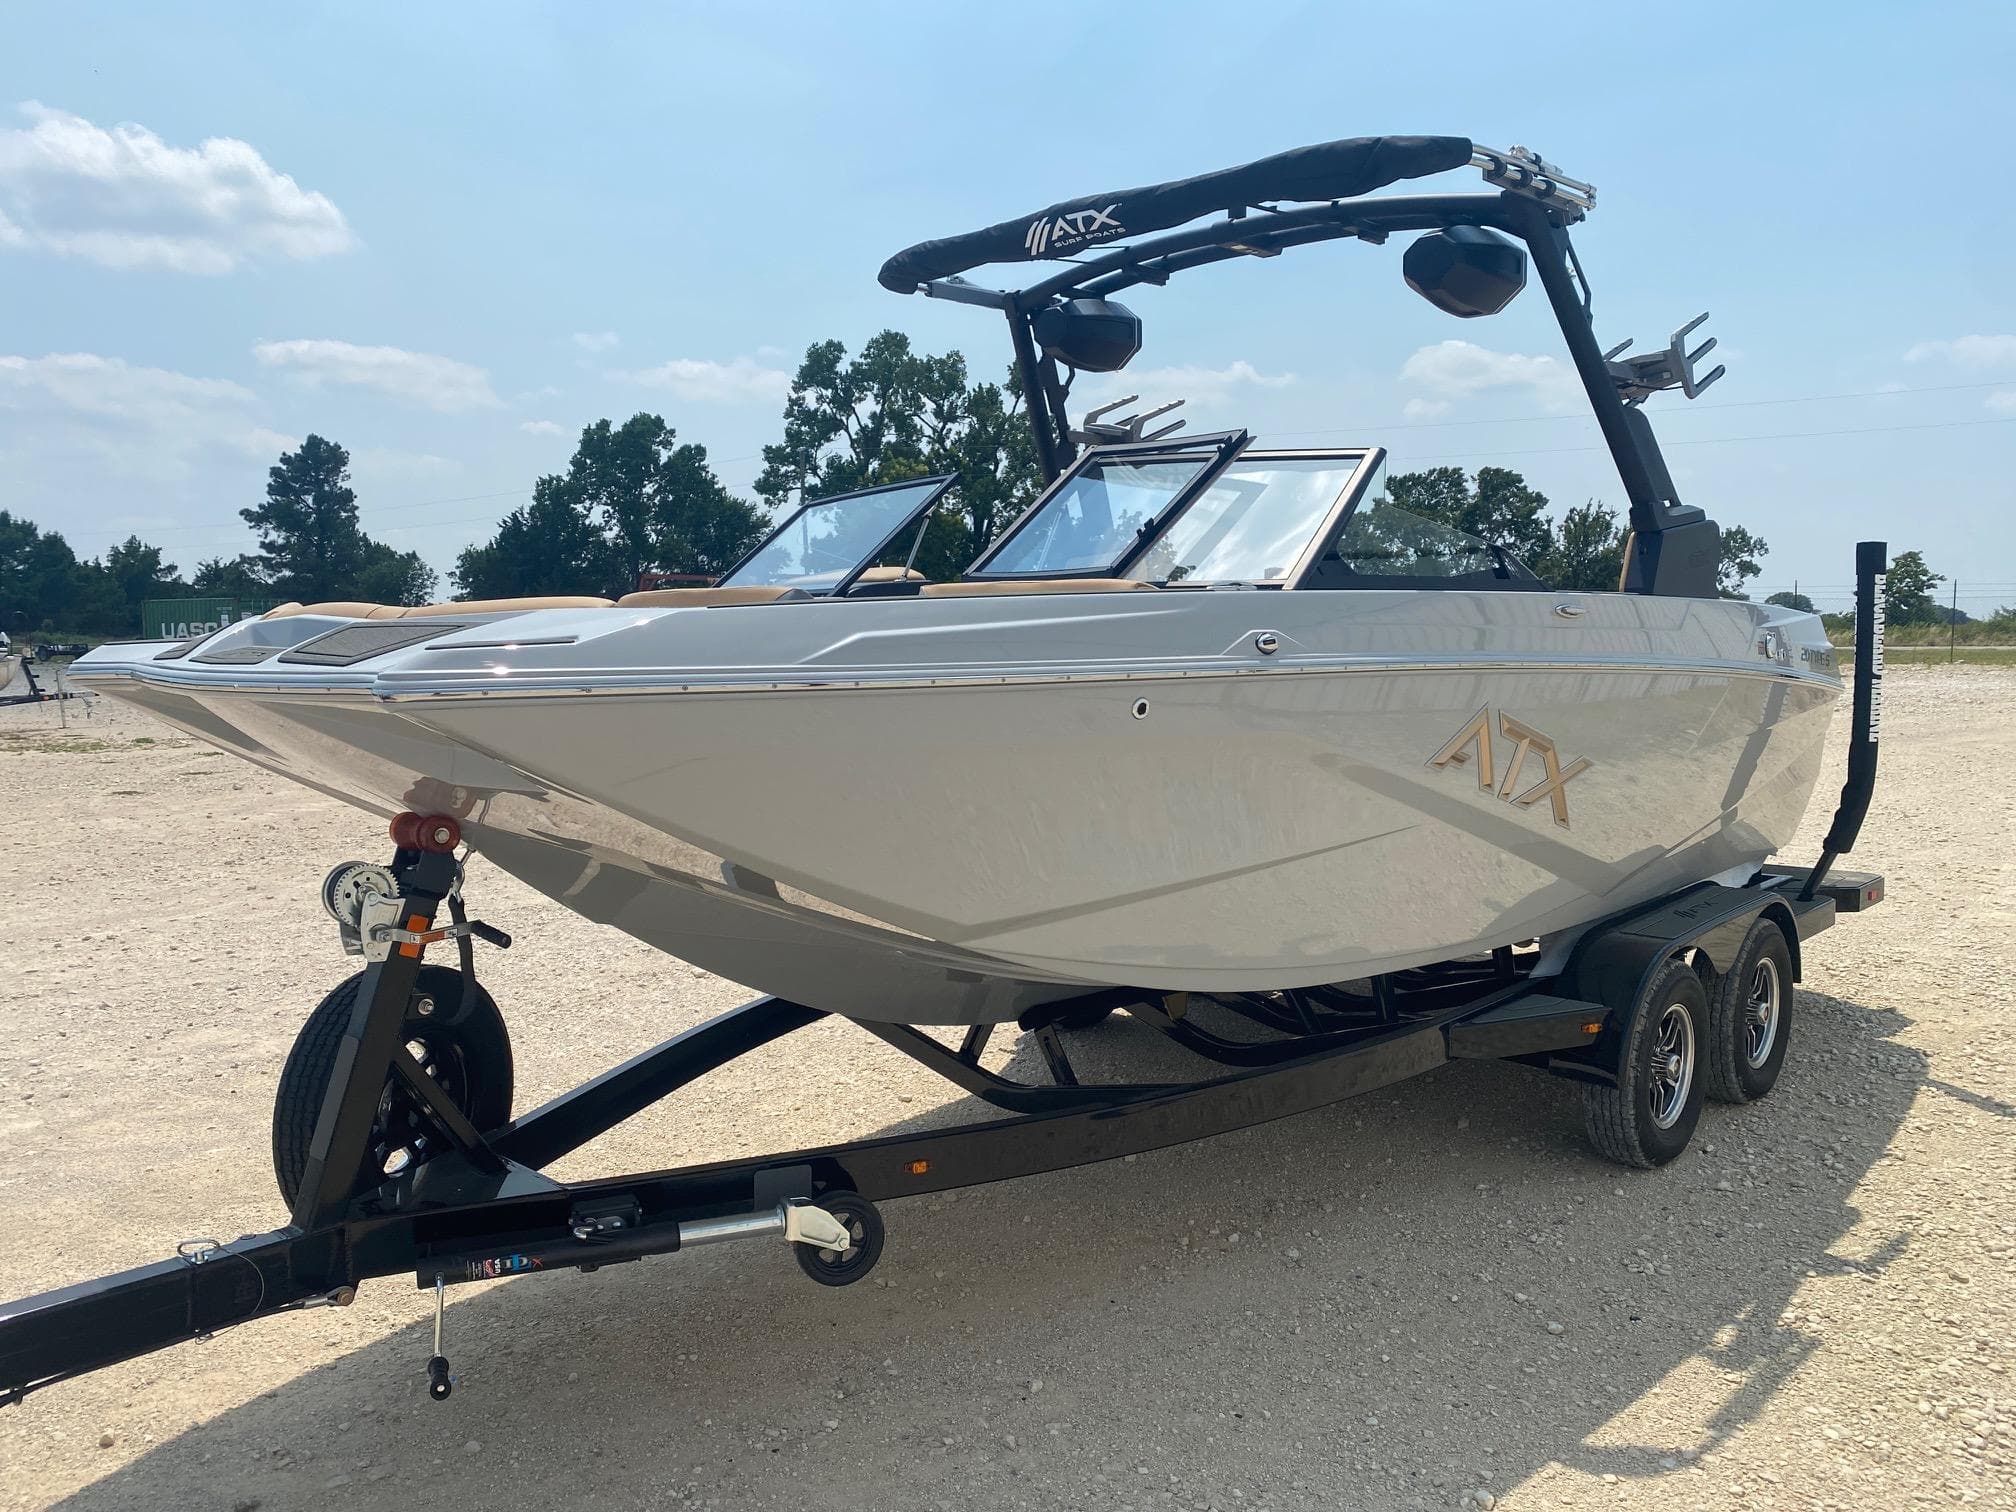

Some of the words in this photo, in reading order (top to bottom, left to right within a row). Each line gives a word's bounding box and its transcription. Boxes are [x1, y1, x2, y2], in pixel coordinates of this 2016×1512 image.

[1051, 204, 1121, 241] ATX
[1054, 236, 1084, 248] SURF
[1086, 227, 1127, 240] BOATS
[161, 622, 218, 639] UASC
[1424, 700, 1594, 830] ATX
